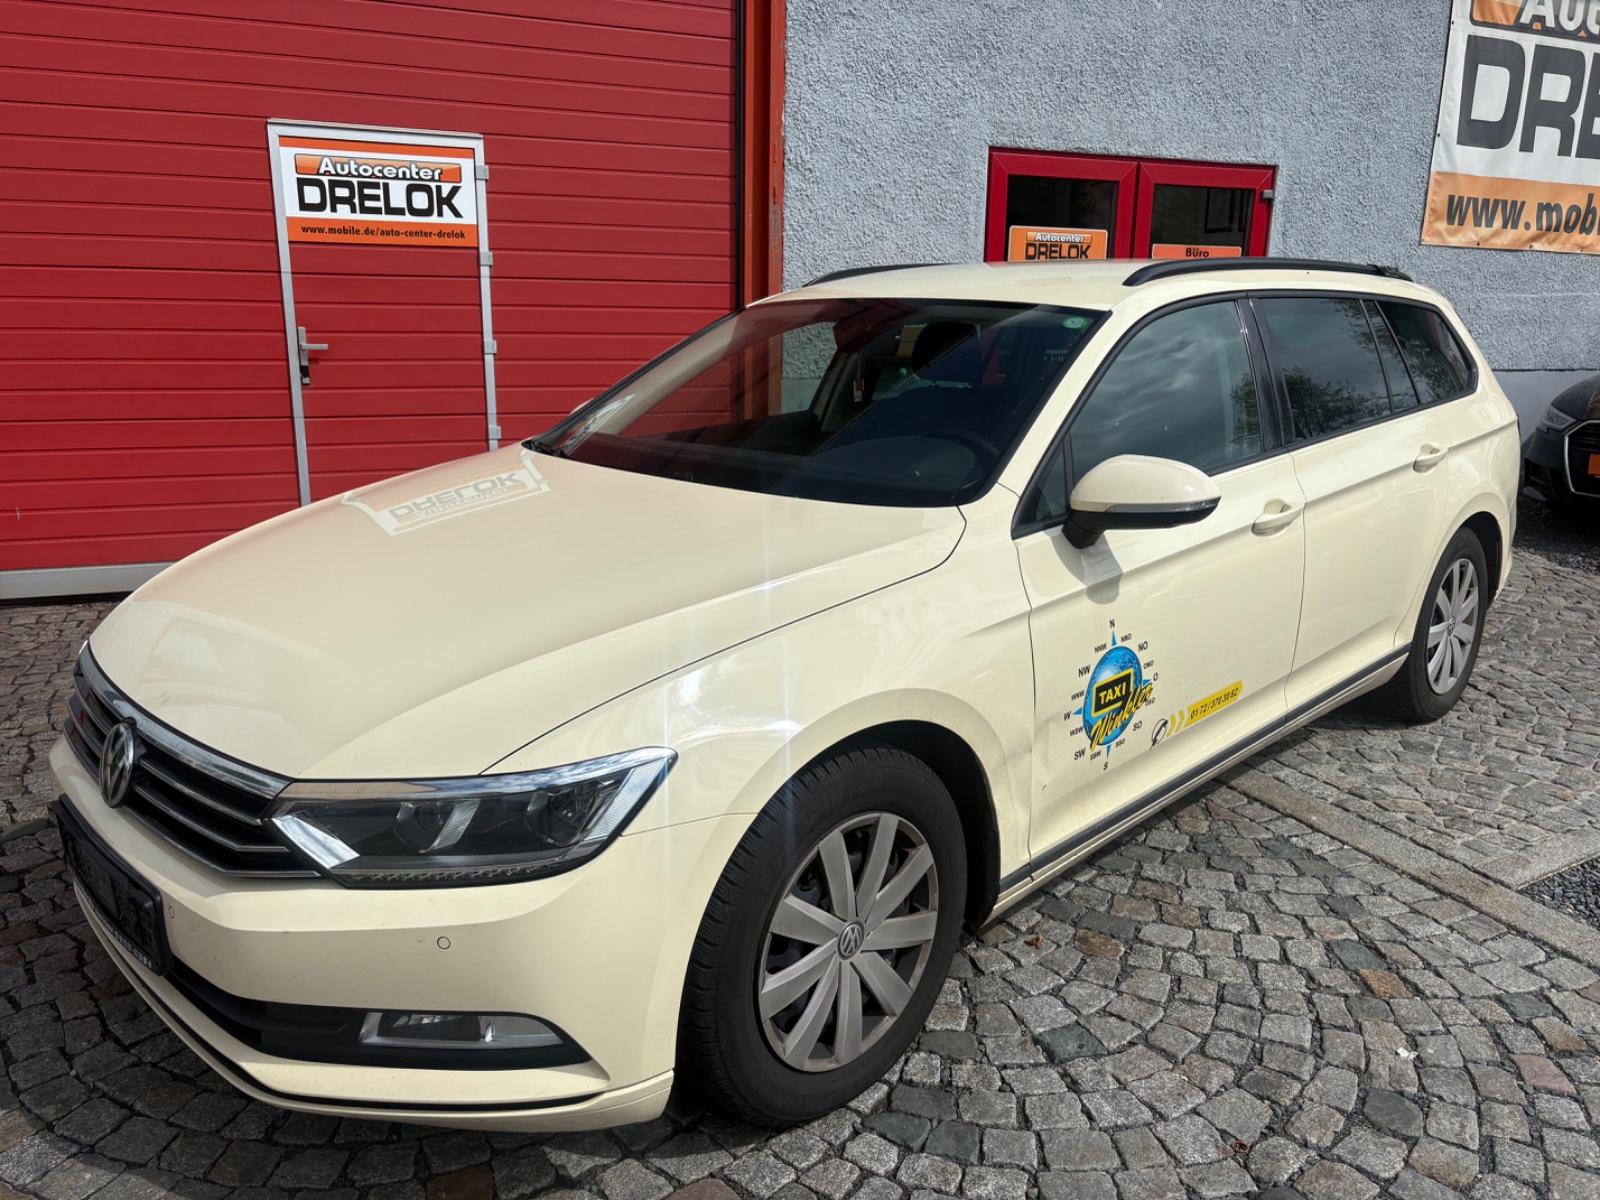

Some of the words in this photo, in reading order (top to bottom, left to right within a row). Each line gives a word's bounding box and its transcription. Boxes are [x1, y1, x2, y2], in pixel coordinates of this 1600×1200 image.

[319, 156, 443, 181] Autocenter
[296, 177, 464, 218] DRELOK
[1446, 193, 1600, 236] www.mob
[301, 225, 466, 240] www.mobile.de/auto-center-drelok
[1035, 232, 1084, 243] Autocenter
[1025, 243, 1091, 260] DRELOK
[1185, 247, 1210, 258] Büro
[1109, 619, 1116, 629] N
[1137, 641, 1149, 652] NO
[1078, 664, 1091, 677] NW
[1099, 682, 1127, 705] TAXI
[1064, 710, 1072, 721] W
[1132, 720, 1142, 731] SO
[1074, 747, 1086, 760] SW
[1103, 761, 1109, 771] S
